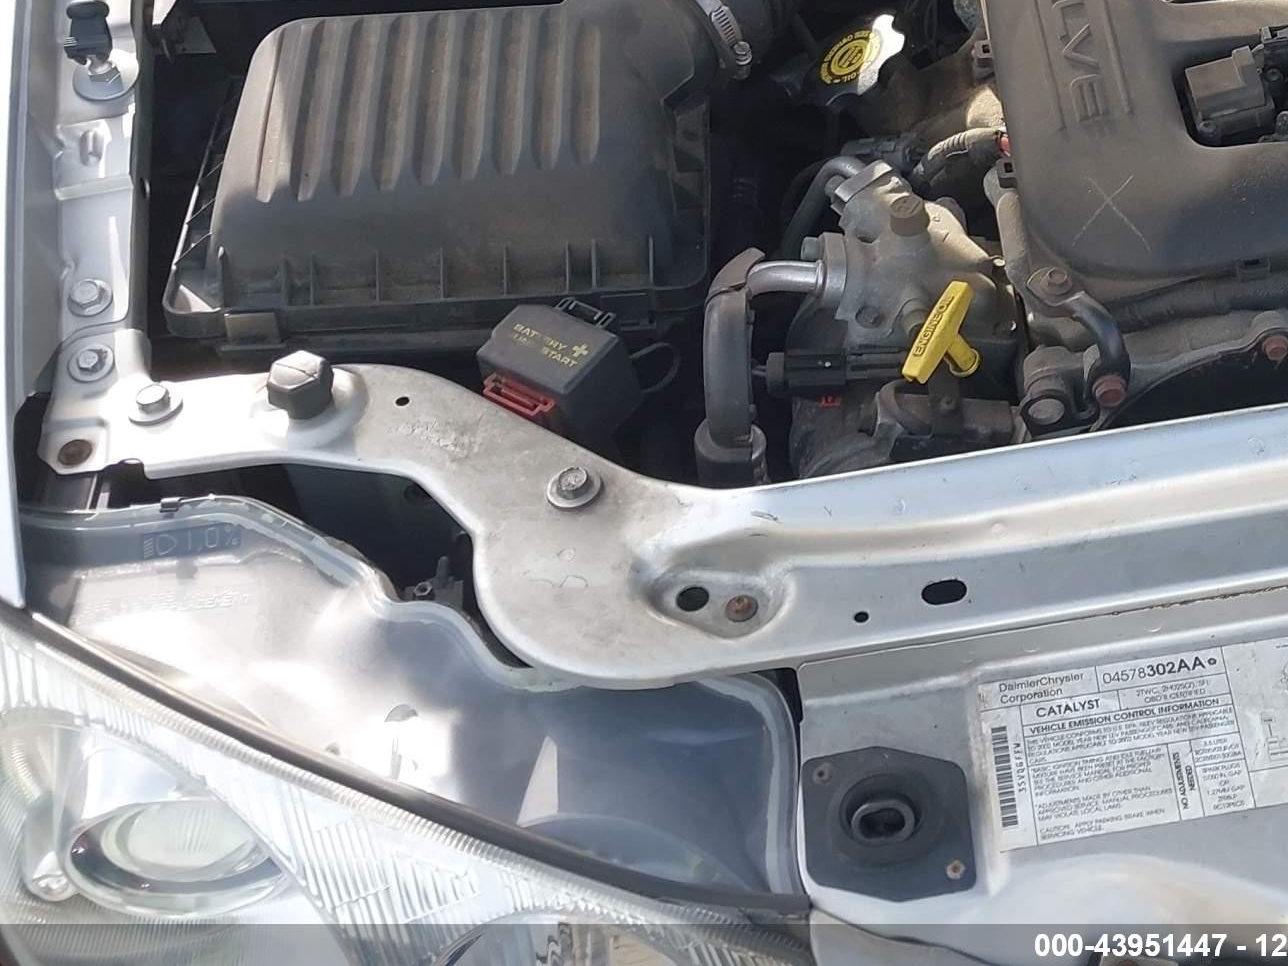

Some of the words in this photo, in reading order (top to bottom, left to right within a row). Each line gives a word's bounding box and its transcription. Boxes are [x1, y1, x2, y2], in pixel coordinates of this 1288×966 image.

[912, 312, 944, 357] ENGINE
[540, 345, 579, 368] START
[1102, 656, 1207, 684] 04578302AA
[998, 672, 1084, 694] DaimlerChrysler
[999, 686, 1064, 705] Corporation
[1029, 722, 1067, 736] VEHICLE
[1068, 714, 1112, 730] EMISSION
[1113, 707, 1155, 722] CONTROL
[1158, 697, 1220, 715] INFORMATION
[1035, 698, 1101, 719] CATALYST
